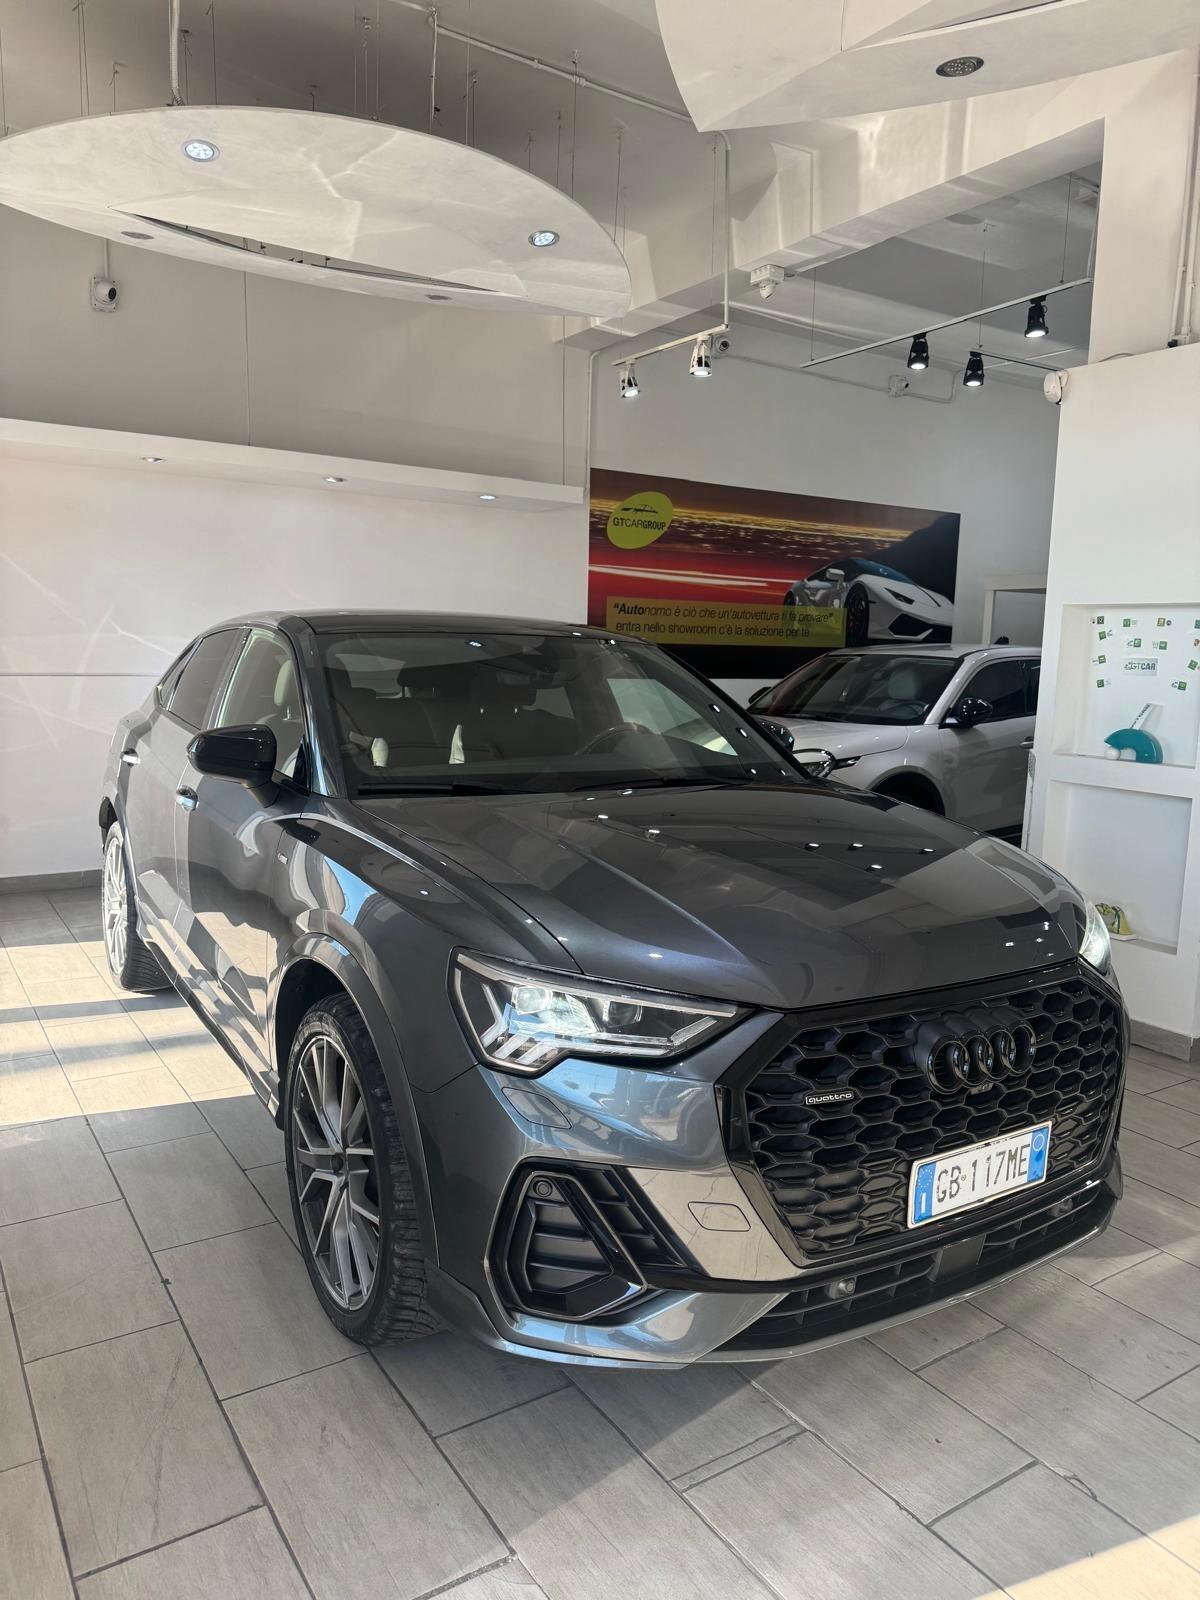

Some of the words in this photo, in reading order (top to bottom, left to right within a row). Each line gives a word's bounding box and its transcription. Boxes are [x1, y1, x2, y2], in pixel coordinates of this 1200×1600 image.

[612, 517, 667, 530] GTCARGROUP
[682, 606, 697, 618] ciò
[699, 607, 716, 619] che
[616, 621, 641, 632] entra
[643, 622, 666, 633] nello
[668, 623, 717, 635] showroom
[719, 624, 733, 635] c'è
[735, 625, 742, 636] la
[744, 625, 784, 637] soluzione
[785, 628, 799, 639] per
[801, 627, 810, 638] te
[808, 1093, 852, 1103] quattro
